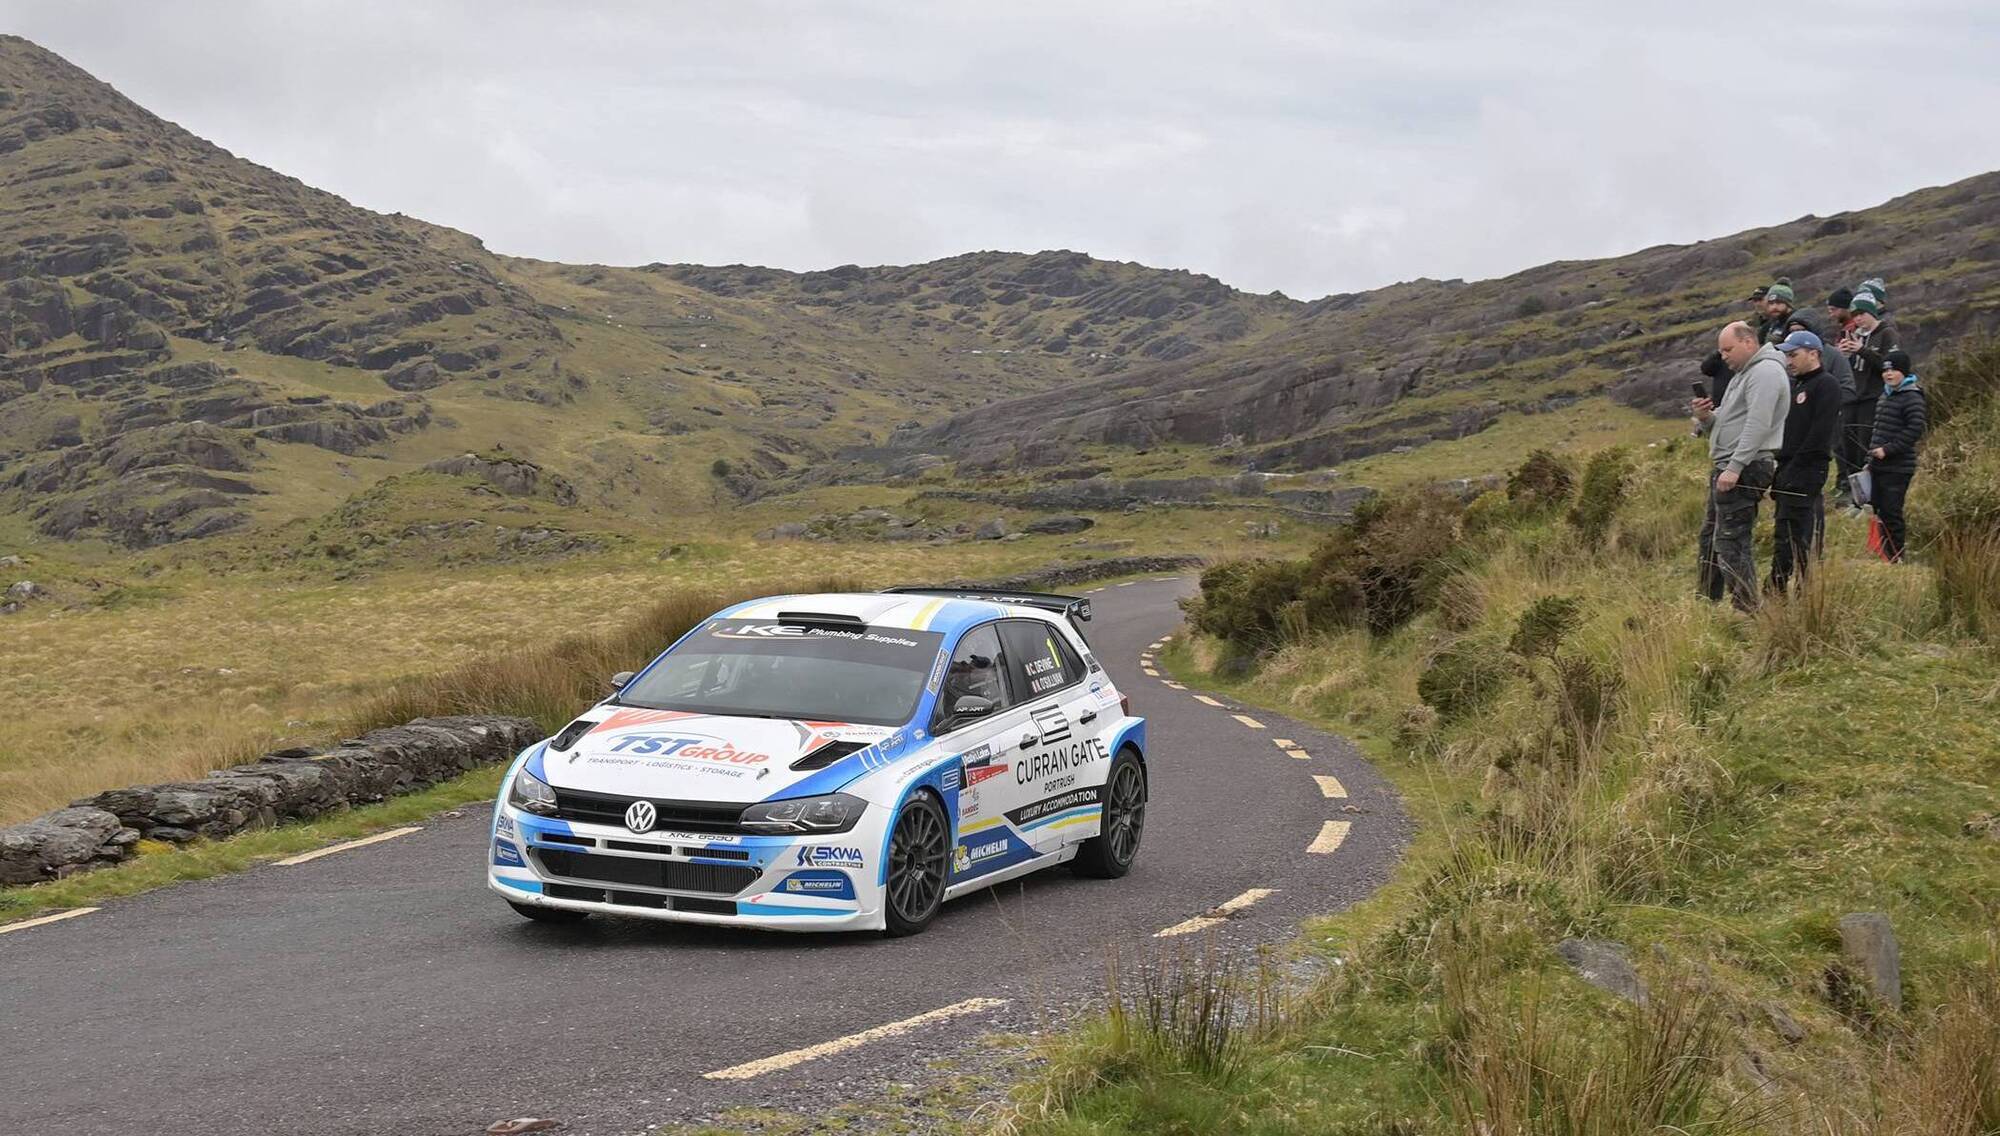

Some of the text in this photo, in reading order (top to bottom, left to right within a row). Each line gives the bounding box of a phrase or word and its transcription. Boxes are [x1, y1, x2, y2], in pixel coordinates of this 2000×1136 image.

[808, 628, 863, 640] Plumbing
[865, 633, 919, 648] Supplies
[1046, 637, 1061, 668] 1
[678, 745, 770, 766] GROUP
[1016, 747, 1068, 785] CURRAN
[1071, 738, 1110, 768] GATE
[587, 757, 745, 778] TRANSPORT LOGISTICS STORAGE
[1044, 774, 1075, 793] PORTRUSH
[1020, 790, 1097, 820] LUXURY ACCOMMODATION
[812, 846, 863, 861] SKWA
[970, 839, 1008, 859] MICHELIN
[803, 881, 842, 889] MICHELIN
